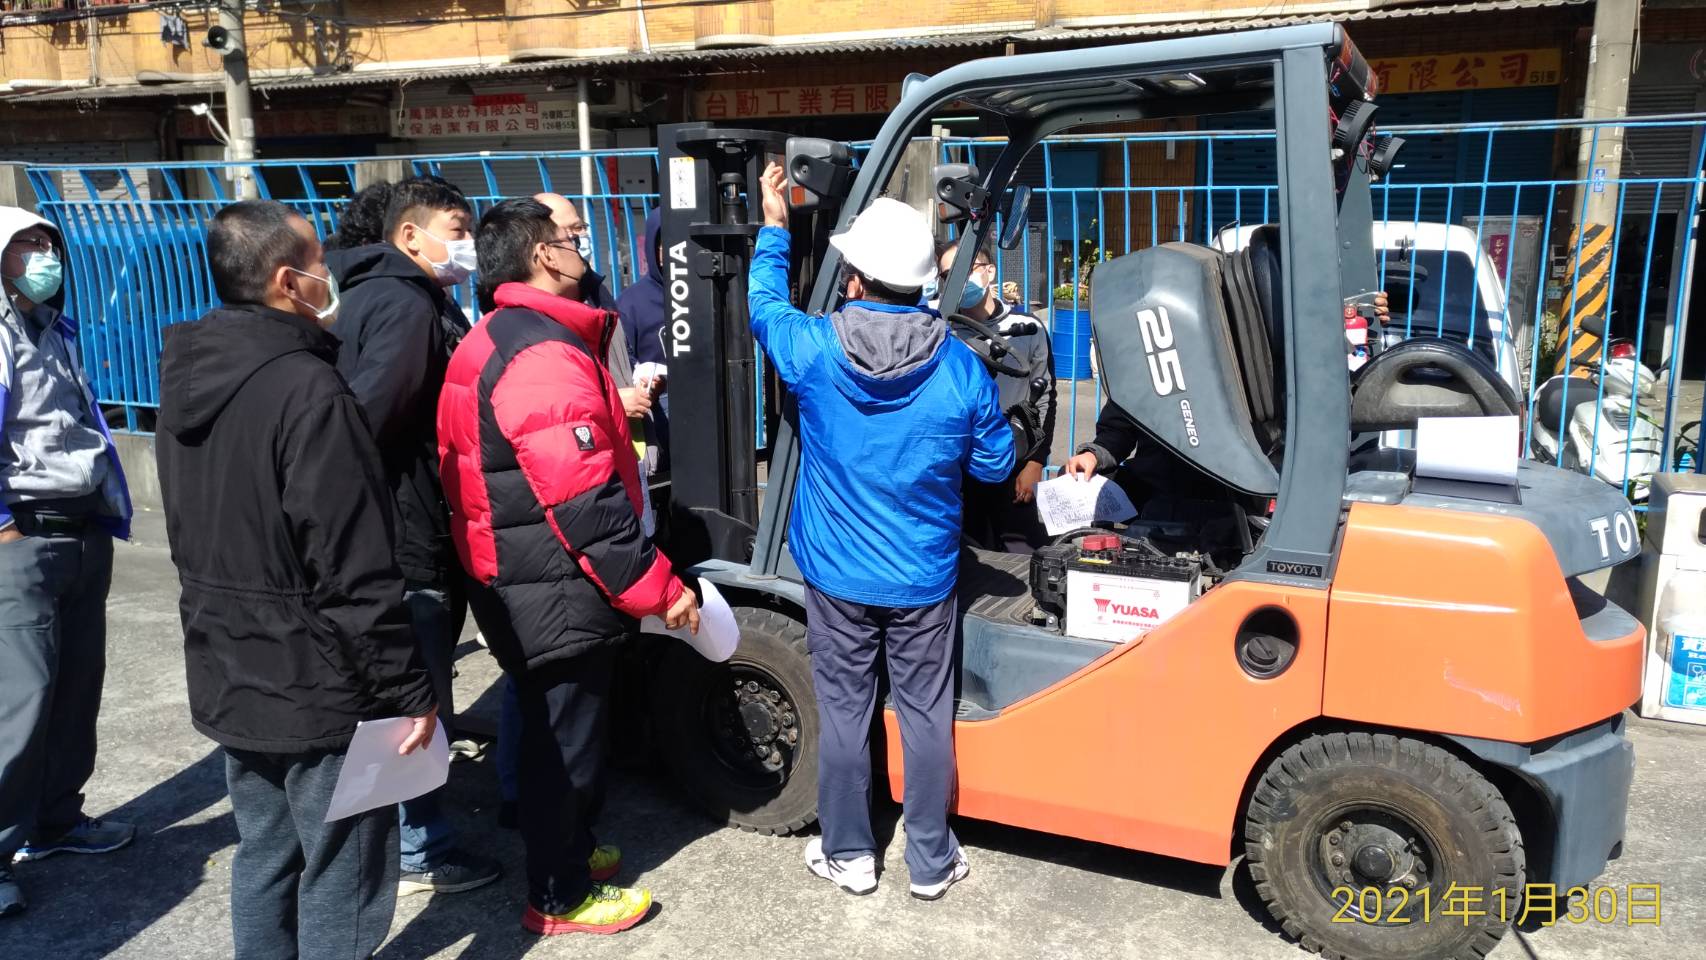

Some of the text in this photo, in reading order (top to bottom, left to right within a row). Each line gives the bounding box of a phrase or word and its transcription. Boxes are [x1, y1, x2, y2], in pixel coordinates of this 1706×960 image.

[1372, 53, 1529, 93] 有限公司
[706, 84, 889, 118] 台動工業有限
[669, 240, 691, 357] TOYOTA
[1136, 306, 1187, 396] 25
[1180, 399, 1200, 447] GENEO
[1590, 511, 1640, 561] TO
[1269, 561, 1319, 576] TOYOTA
[1111, 603, 1160, 619] YUASA
